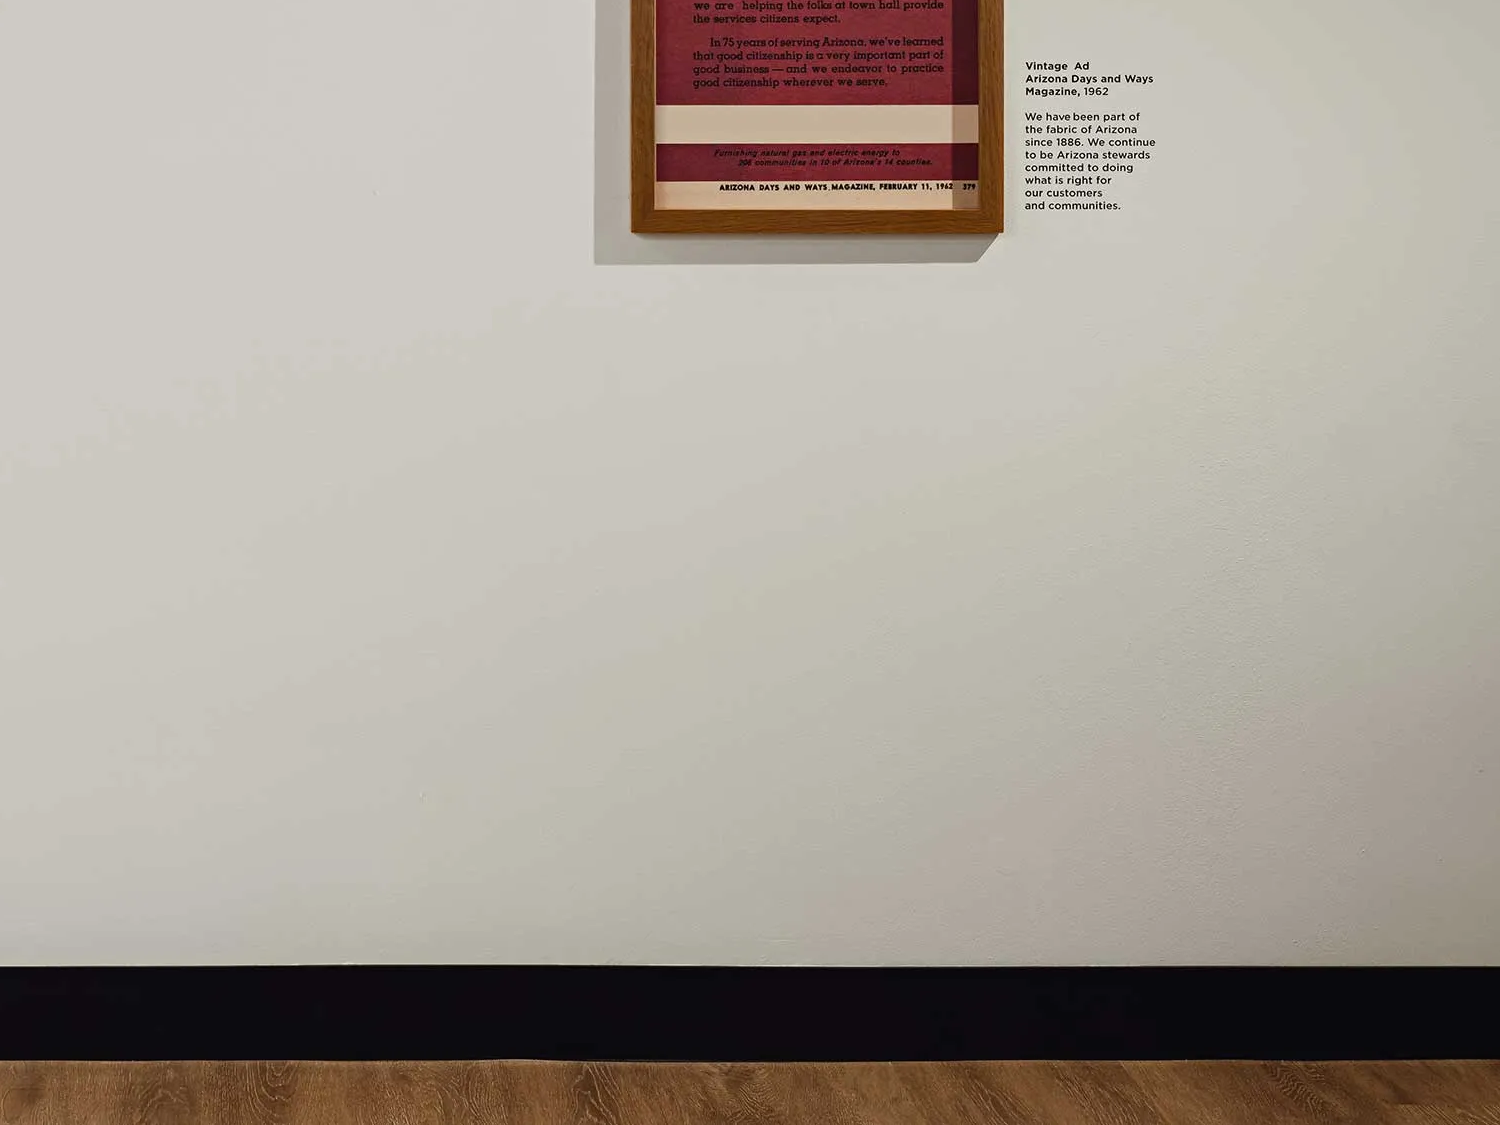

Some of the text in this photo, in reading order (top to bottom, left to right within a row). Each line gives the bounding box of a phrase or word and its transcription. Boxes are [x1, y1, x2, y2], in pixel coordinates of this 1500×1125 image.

[693, 0, 944, 13] we are helping the folks at town hall provide
[693, 14, 841, 26] the services citizens expect.
[710, 37, 722, 47] In
[722, 37, 735, 47] 75
[736, 39, 767, 49] years
[767, 37, 779, 47] of
[780, 37, 820, 49] serving
[869, 37, 900, 47] we've
[902, 37, 944, 47] learned
[693, 51, 944, 63] that good citizenship is a very important part of
[693, 64, 944, 76] good business and we endeavor to practice
[1025, 62, 1090, 72] Vintage Ad
[693, 77, 888, 89] good citizenship wherever we serve.
[1025, 75, 1154, 85] Arizona Days and Ways
[1025, 87, 1109, 97] Magazine, 1962
[1025, 113, 1141, 123] We have been part of
[1025, 125, 1137, 134] the fabric of Arizona
[1025, 138, 1156, 147] since 1886. We continue
[1025, 151, 1151, 159] to be Arizona stewards
[1025, 163, 1134, 173] committed to doing
[1025, 176, 1112, 186] what is right for
[921, 184, 932, 192] 11,
[1025, 201, 1121, 210] and communities.
